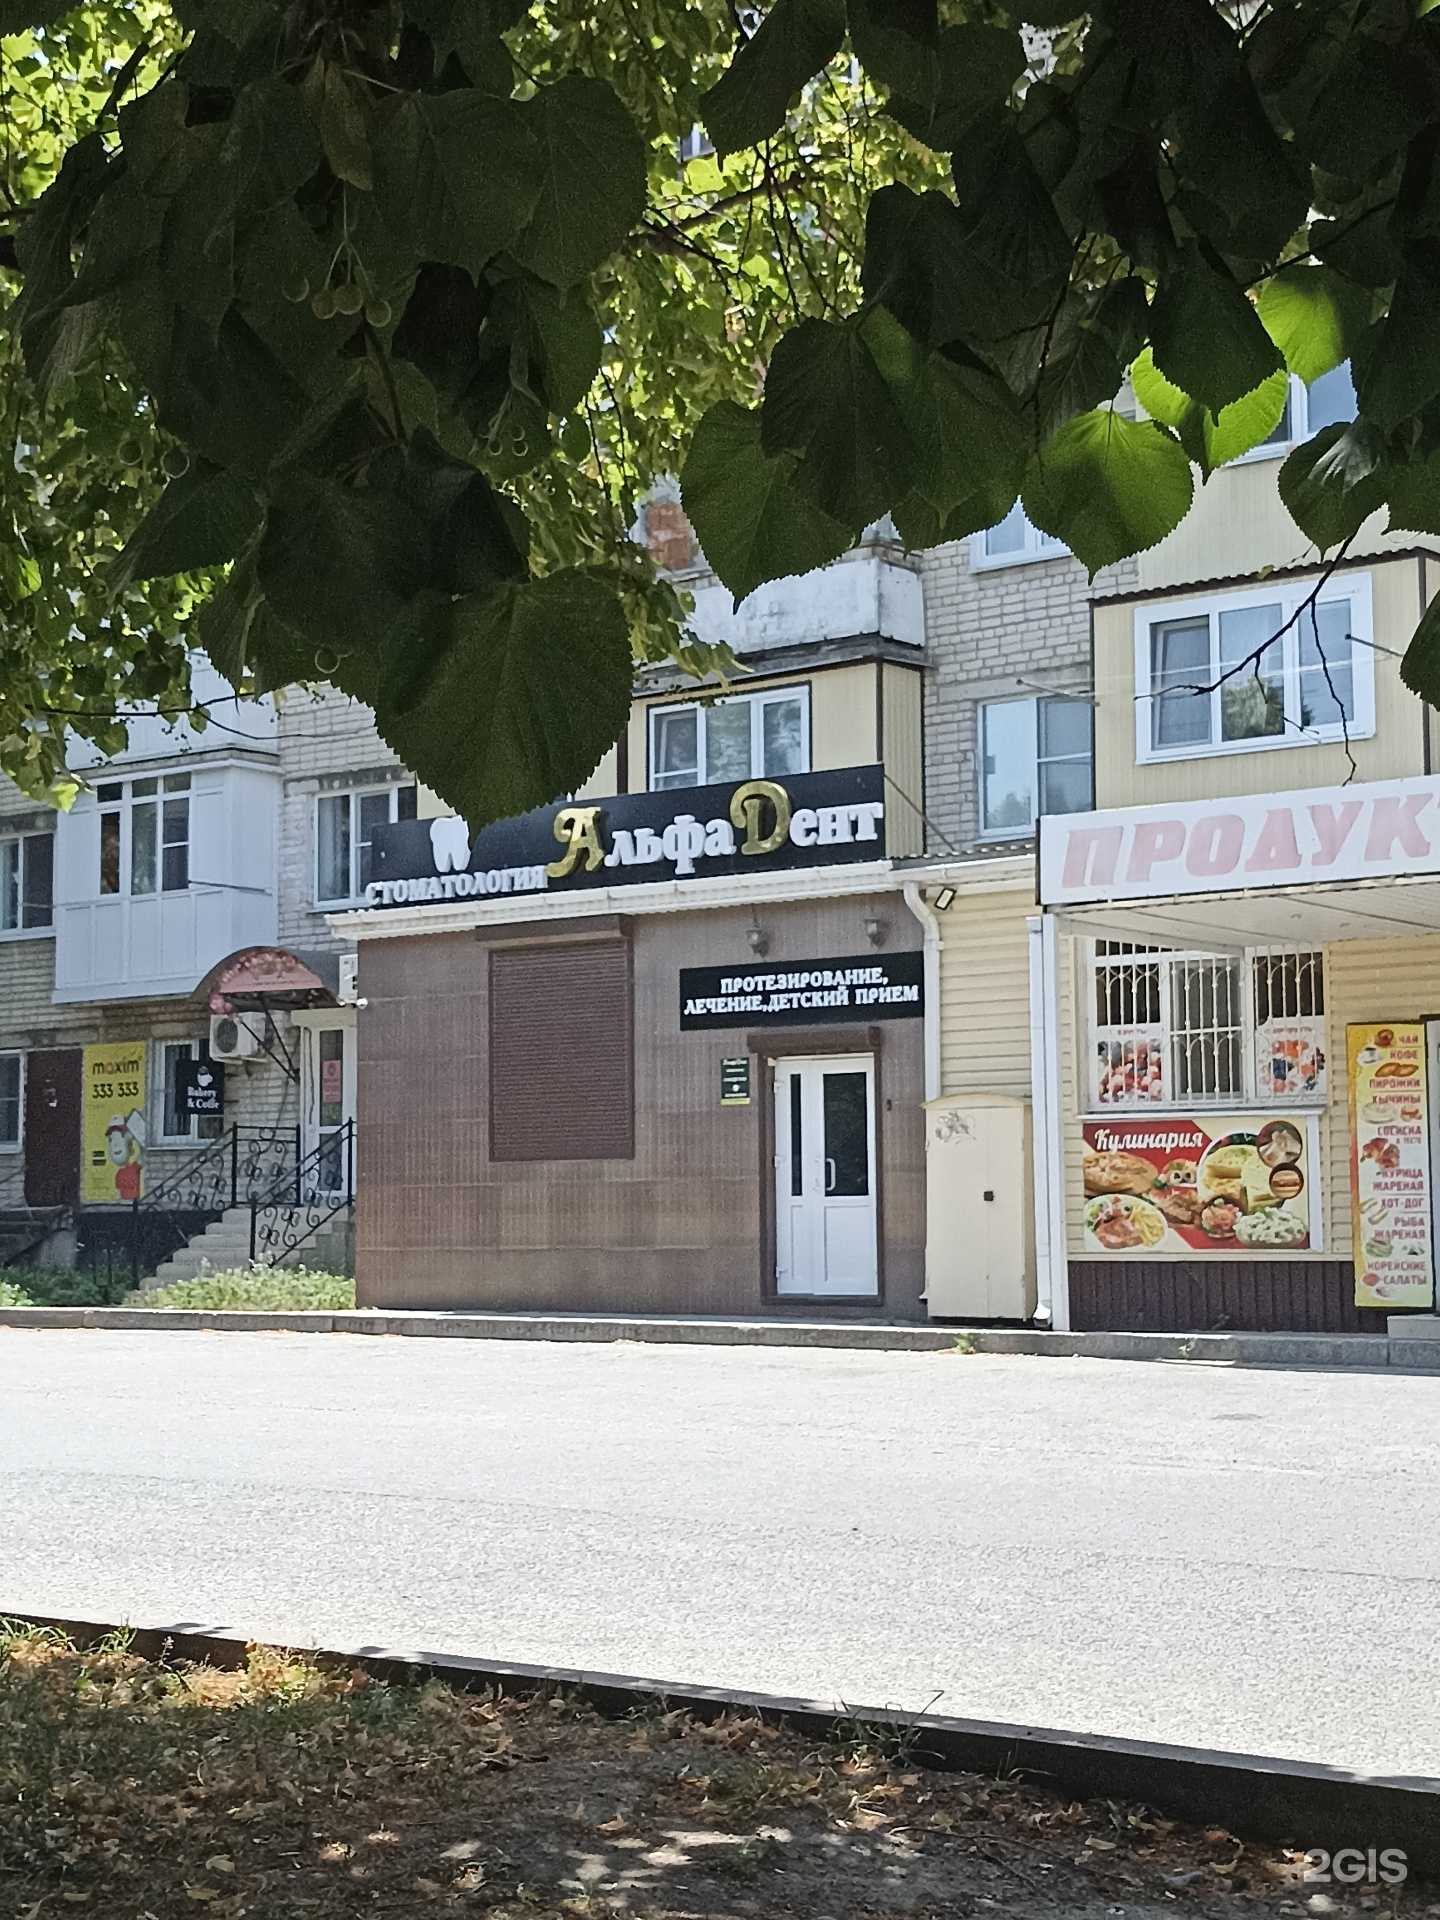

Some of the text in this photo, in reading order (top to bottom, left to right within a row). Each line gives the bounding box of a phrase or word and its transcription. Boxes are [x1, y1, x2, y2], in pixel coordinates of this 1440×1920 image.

[1062, 792, 1440, 888] ПРОДУК
[364, 863, 548, 907] СТОМАТОЛОГИЯ
[719, 966, 889, 995] ПРОТЕЗИРОВАНИЕ,
[854, 983, 920, 1007] ПРИЕМ
[1398, 1033, 1419, 1044] ЧАЙ
[1389, 1049, 1418, 1060] КОФЕ
[92, 1057, 140, 1075] maxim
[1369, 1078, 1421, 1089] ПИРОЖКИ
[92, 1081, 140, 1099] 333 333
[1093, 1128, 1204, 1154] Кулинария
[1381, 1168, 1424, 1180] КУРИЦА
[1372, 1181, 1425, 1192] ЖАРЕНАЯ
[1393, 1216, 1426, 1228] РЫБА
[1374, 1229, 1426, 1241] ЖАРЕНАЯ
[1383, 1274, 1428, 1286] САЛАТЫ
